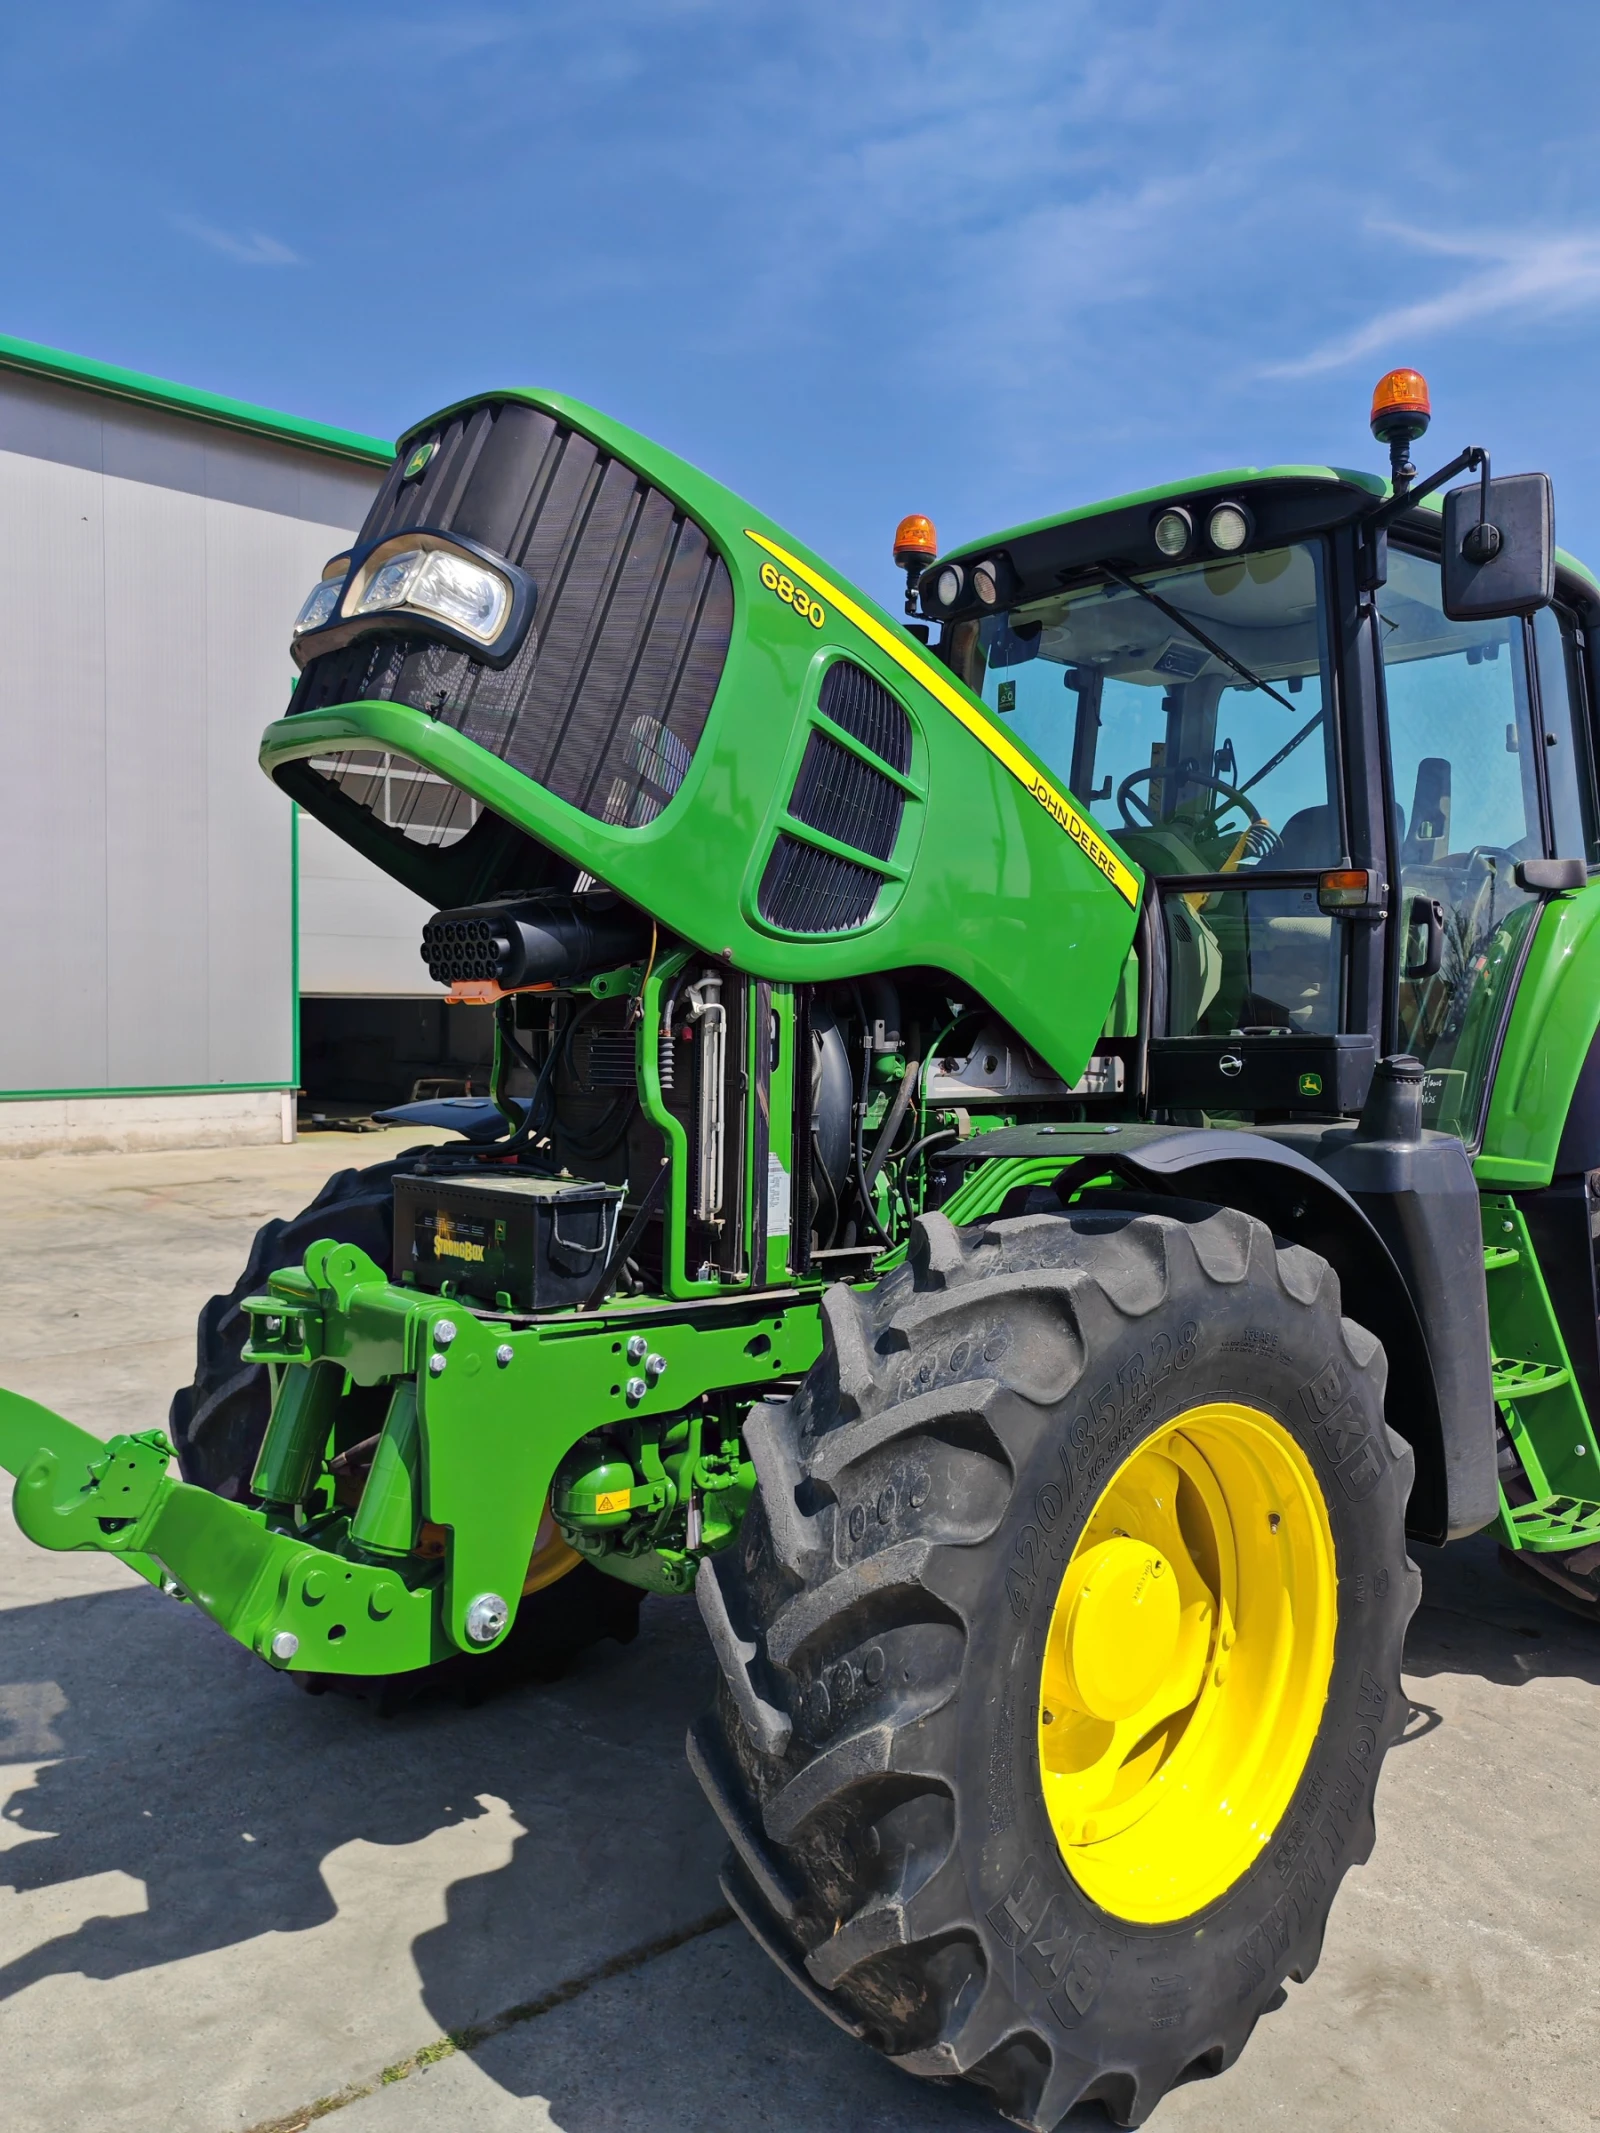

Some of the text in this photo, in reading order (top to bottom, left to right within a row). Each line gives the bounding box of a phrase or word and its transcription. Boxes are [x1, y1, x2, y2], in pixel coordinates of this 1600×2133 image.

[760, 562, 825, 629] 6830
[1028, 777, 1117, 880] JOHN DEERE
[1004, 1320, 1199, 1619] 420/85R28
[1304, 1357, 1385, 1496] BKT
[998, 1866, 1102, 2022] BKT
